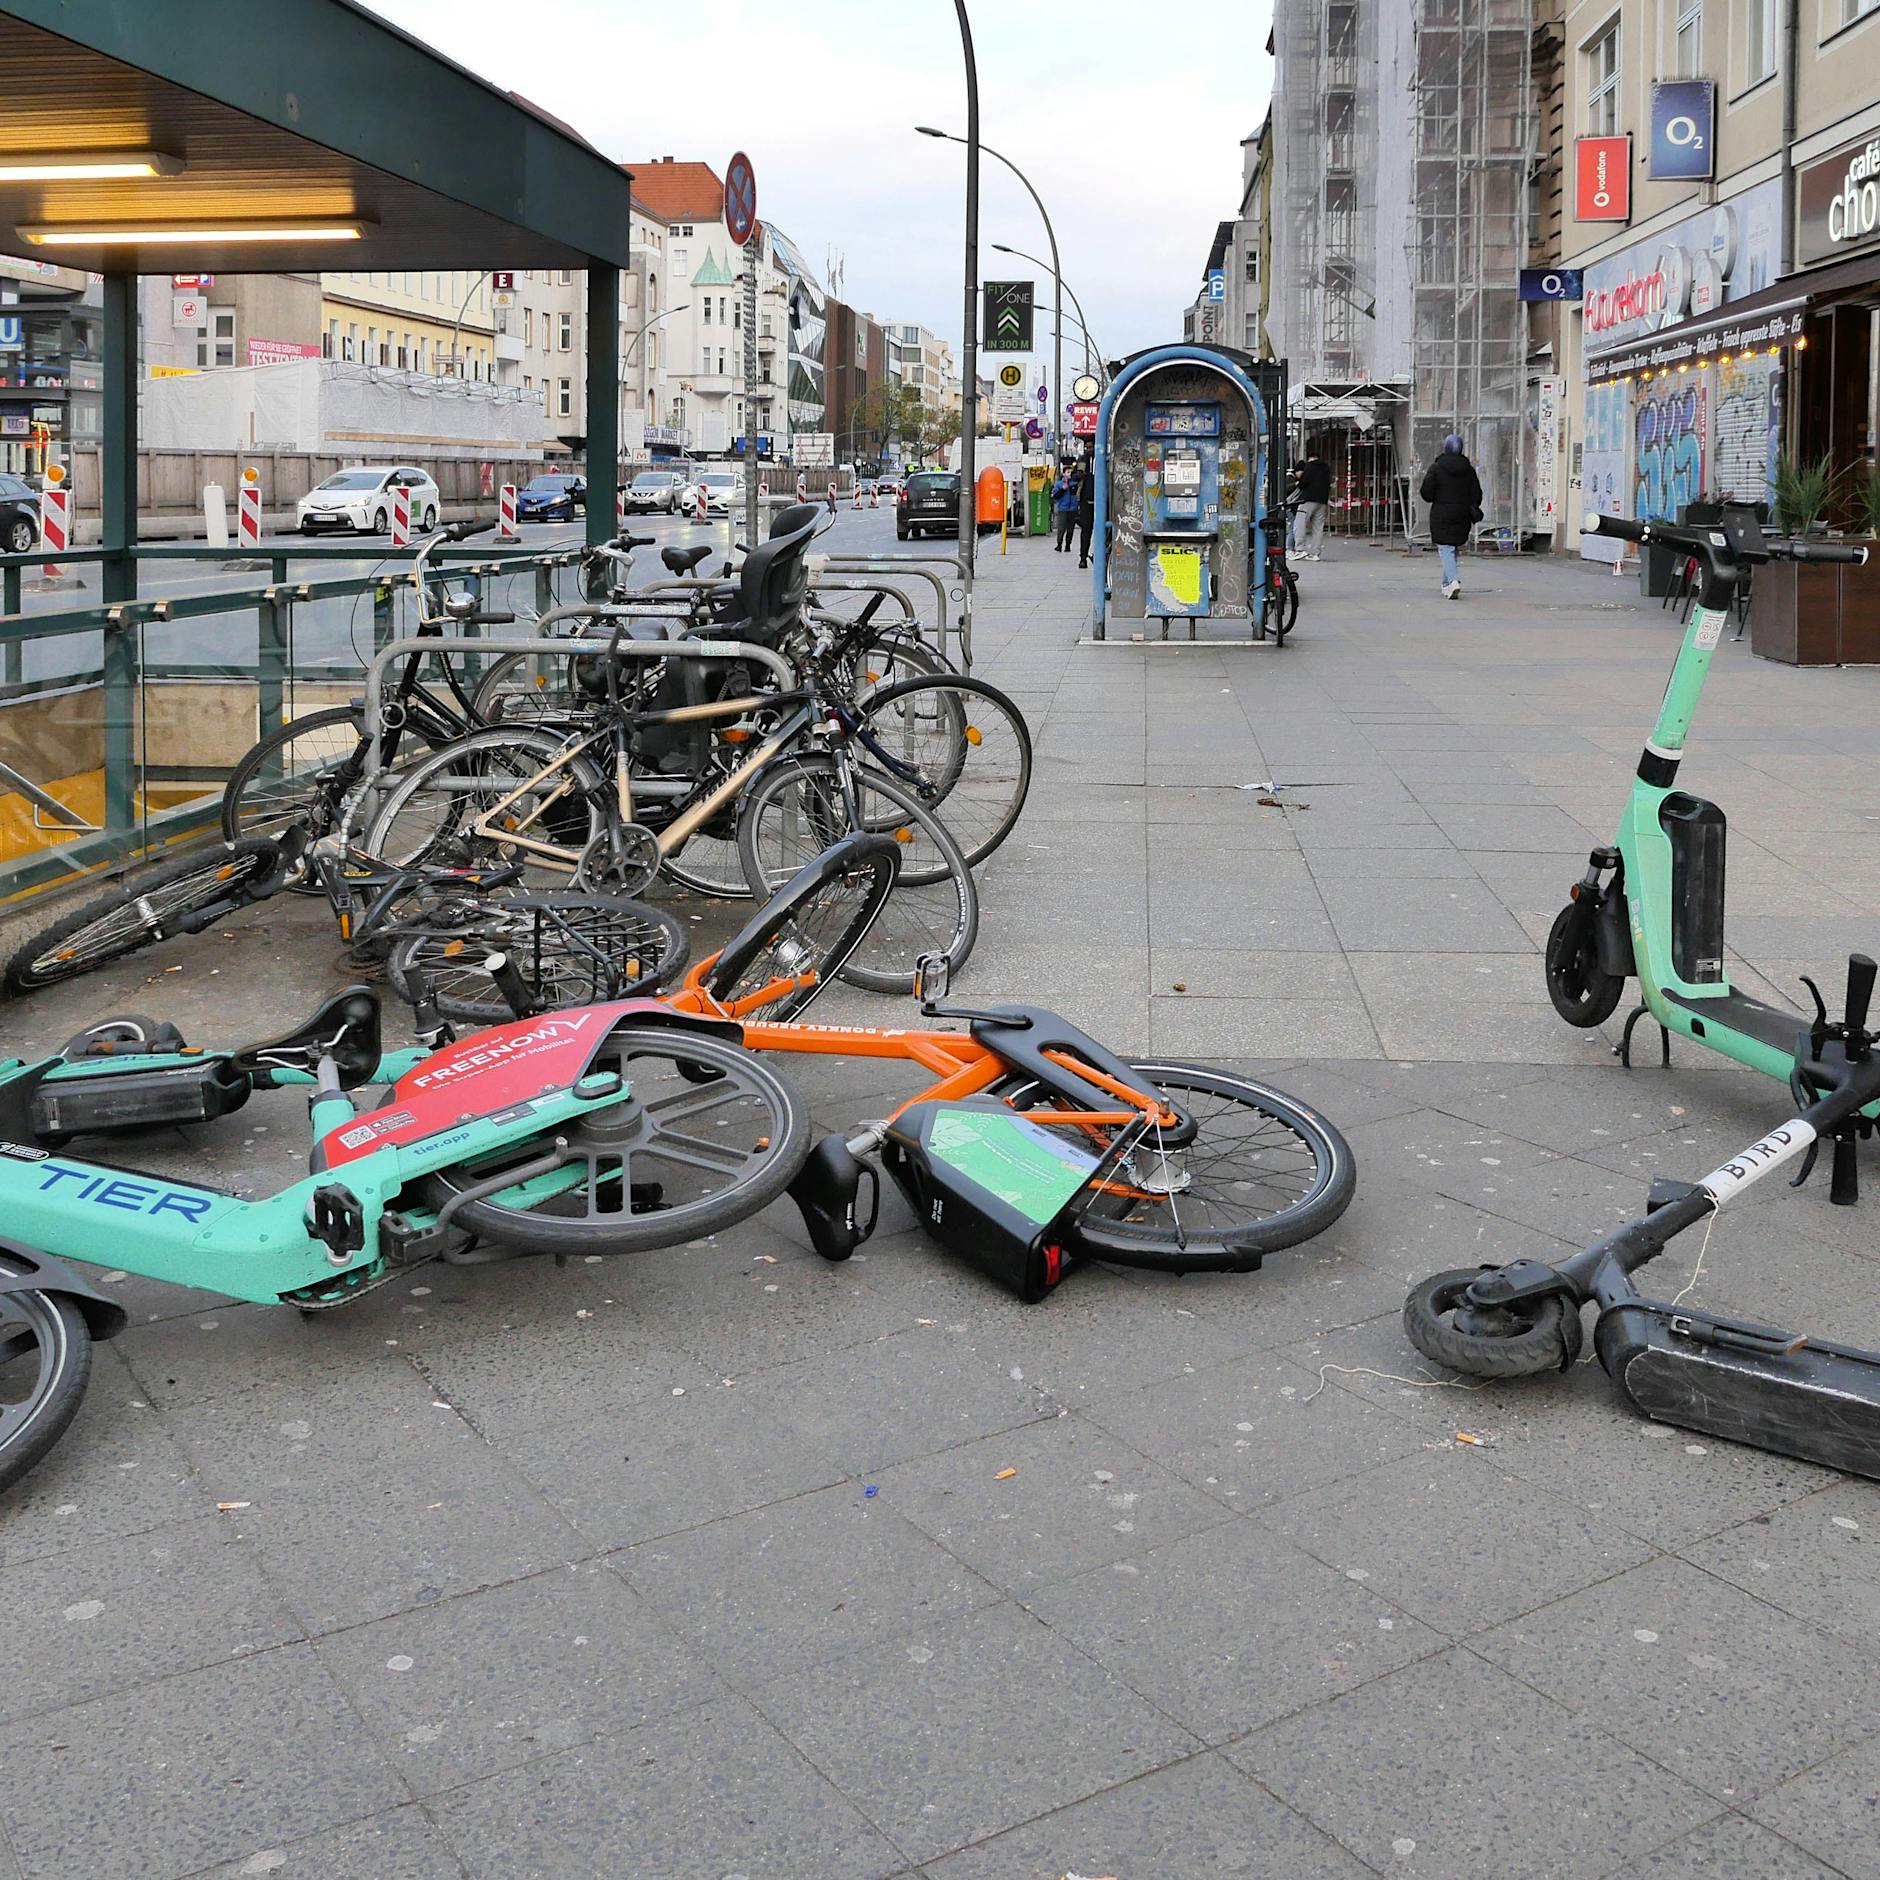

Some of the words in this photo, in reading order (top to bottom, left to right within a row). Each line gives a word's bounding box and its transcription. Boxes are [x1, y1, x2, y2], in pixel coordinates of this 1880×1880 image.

[1666, 116, 1703, 149] O2
[1597, 150, 1607, 191] vodafone
[498, 274, 508, 288] E
[1212, 281, 1224, 297] P
[1541, 275, 1566, 297] O2
[987, 285, 1006, 296] FIT
[1006, 292, 1031, 304] ONE
[1583, 268, 1666, 334] futurekom
[0, 317, 18, 343] U
[987, 339, 997, 349] IN
[1000, 339, 1018, 349] 300
[1020, 339, 1029, 349] M
[1005, 369, 1015, 382] H
[1074, 406, 1098, 415] REWE
[1630, 898, 1643, 942] Bolt
[721, 1019, 801, 1030] REPUBL
[807, 1024, 877, 1034] DONKEY
[413, 1025, 559, 1088] FREENOW
[412, 1130, 471, 1156] tier.app
[1720, 1129, 1793, 1180] BIRD
[40, 1163, 212, 1224] TIER
